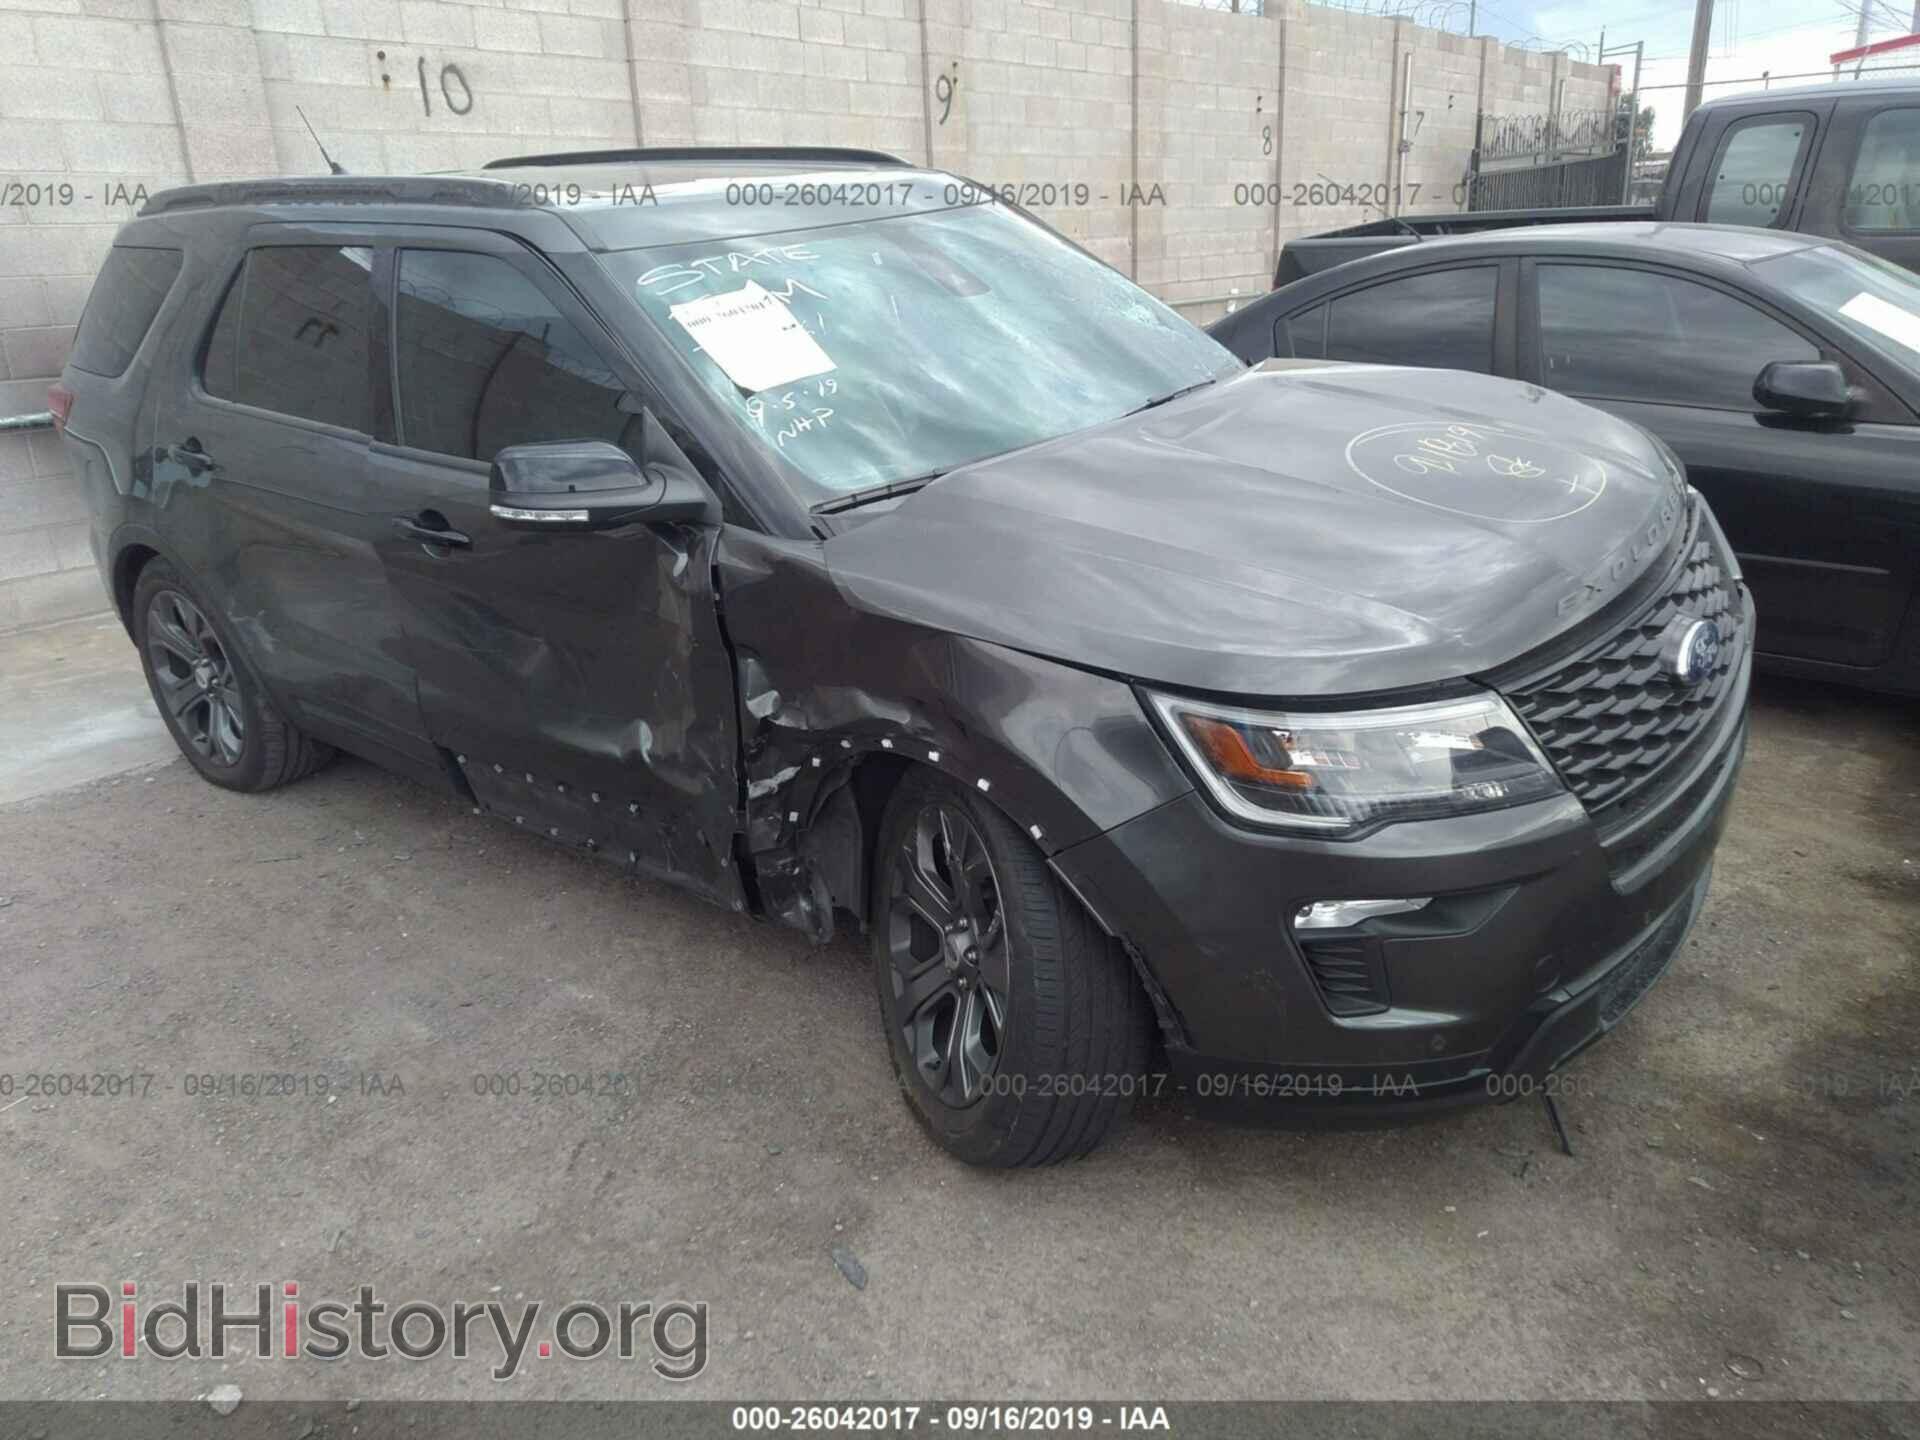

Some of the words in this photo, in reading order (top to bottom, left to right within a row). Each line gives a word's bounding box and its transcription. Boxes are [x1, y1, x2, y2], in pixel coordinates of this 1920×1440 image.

[417, 56, 473, 117] 10
[935, 74, 953, 126] 9
[1262, 125, 1273, 156] 8
[1415, 110, 1425, 137] 7
[637, 244, 821, 296] STATE
